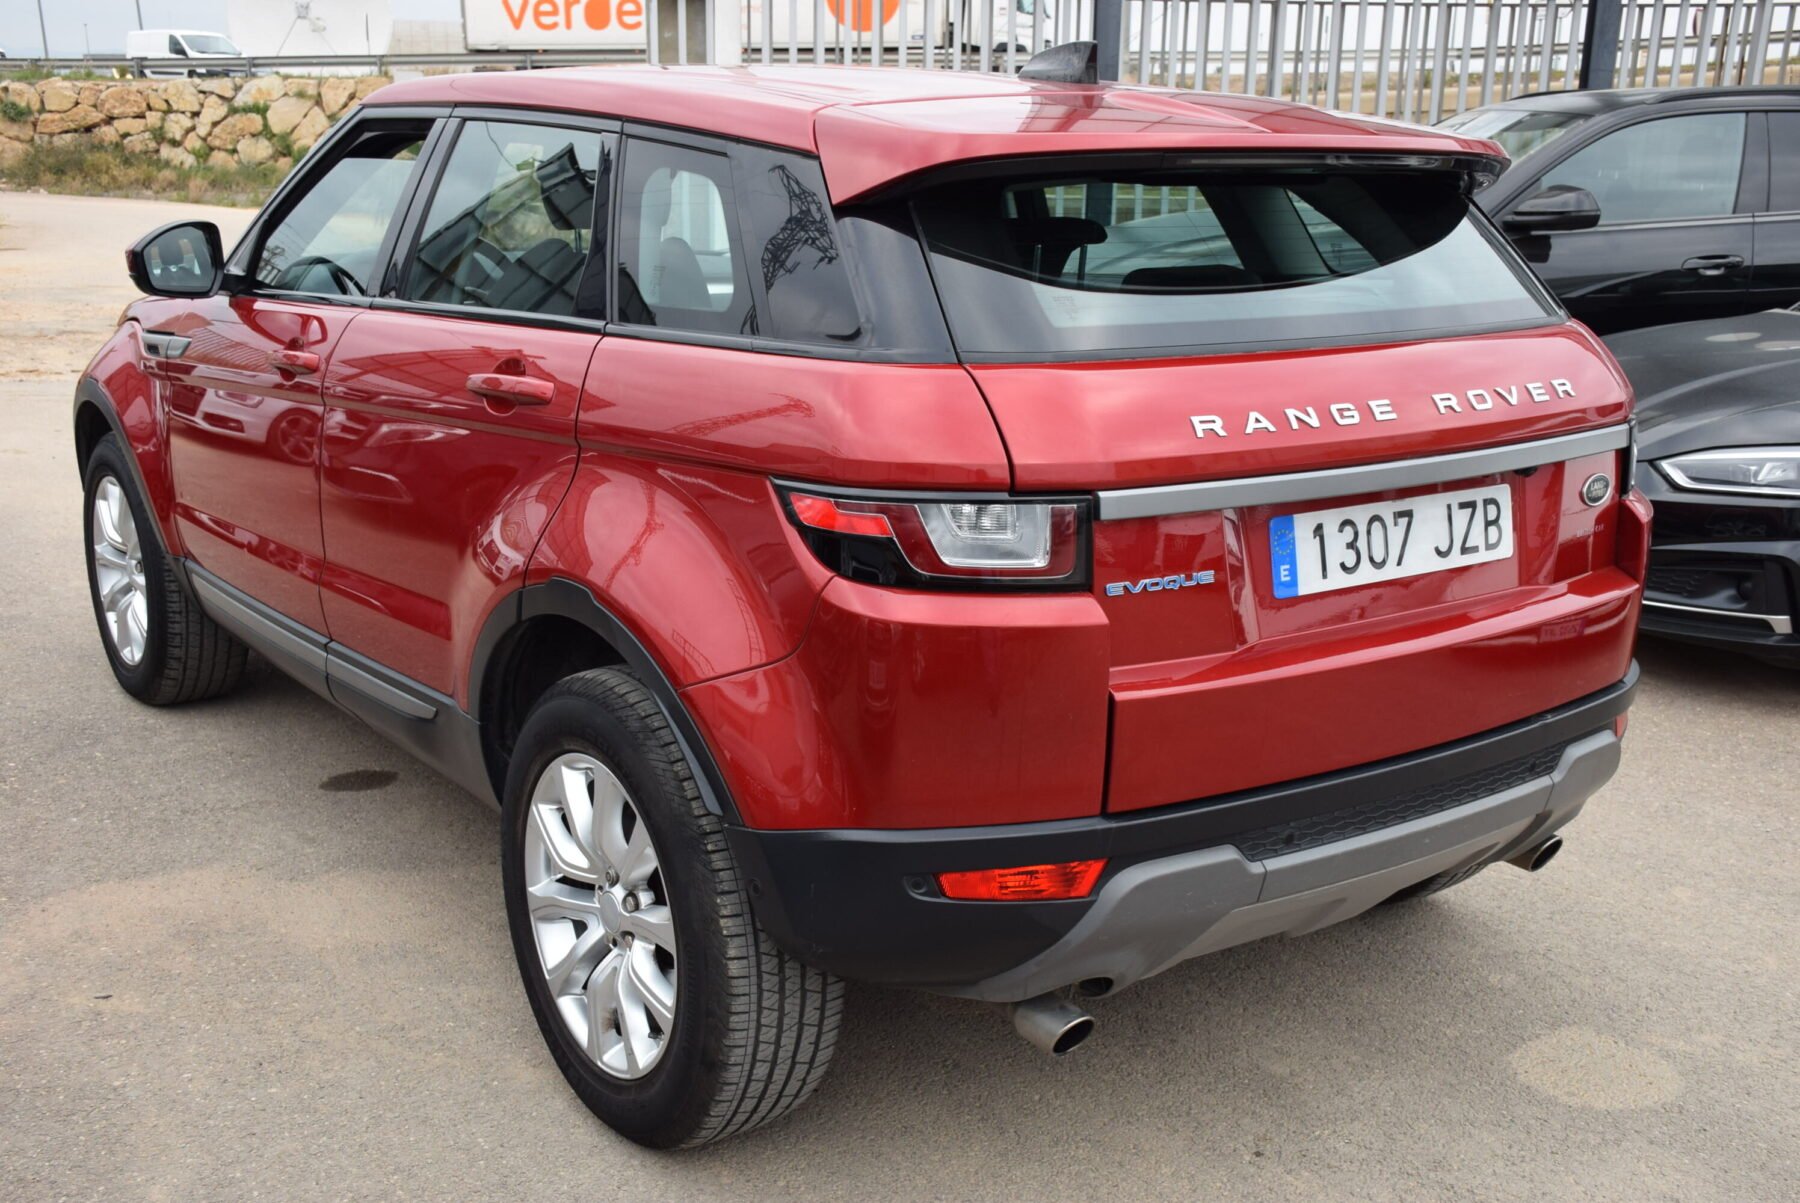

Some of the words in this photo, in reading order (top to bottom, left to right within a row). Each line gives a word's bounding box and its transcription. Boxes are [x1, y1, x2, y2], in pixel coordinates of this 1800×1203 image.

[1190, 399, 1398, 438] RANGE
[1431, 378, 1576, 414] ROVER
[1312, 508, 1414, 580] 1307
[1434, 497, 1503, 559] JZB
[1106, 569, 1215, 596] EVOQUE
[1280, 565, 1291, 581] E
